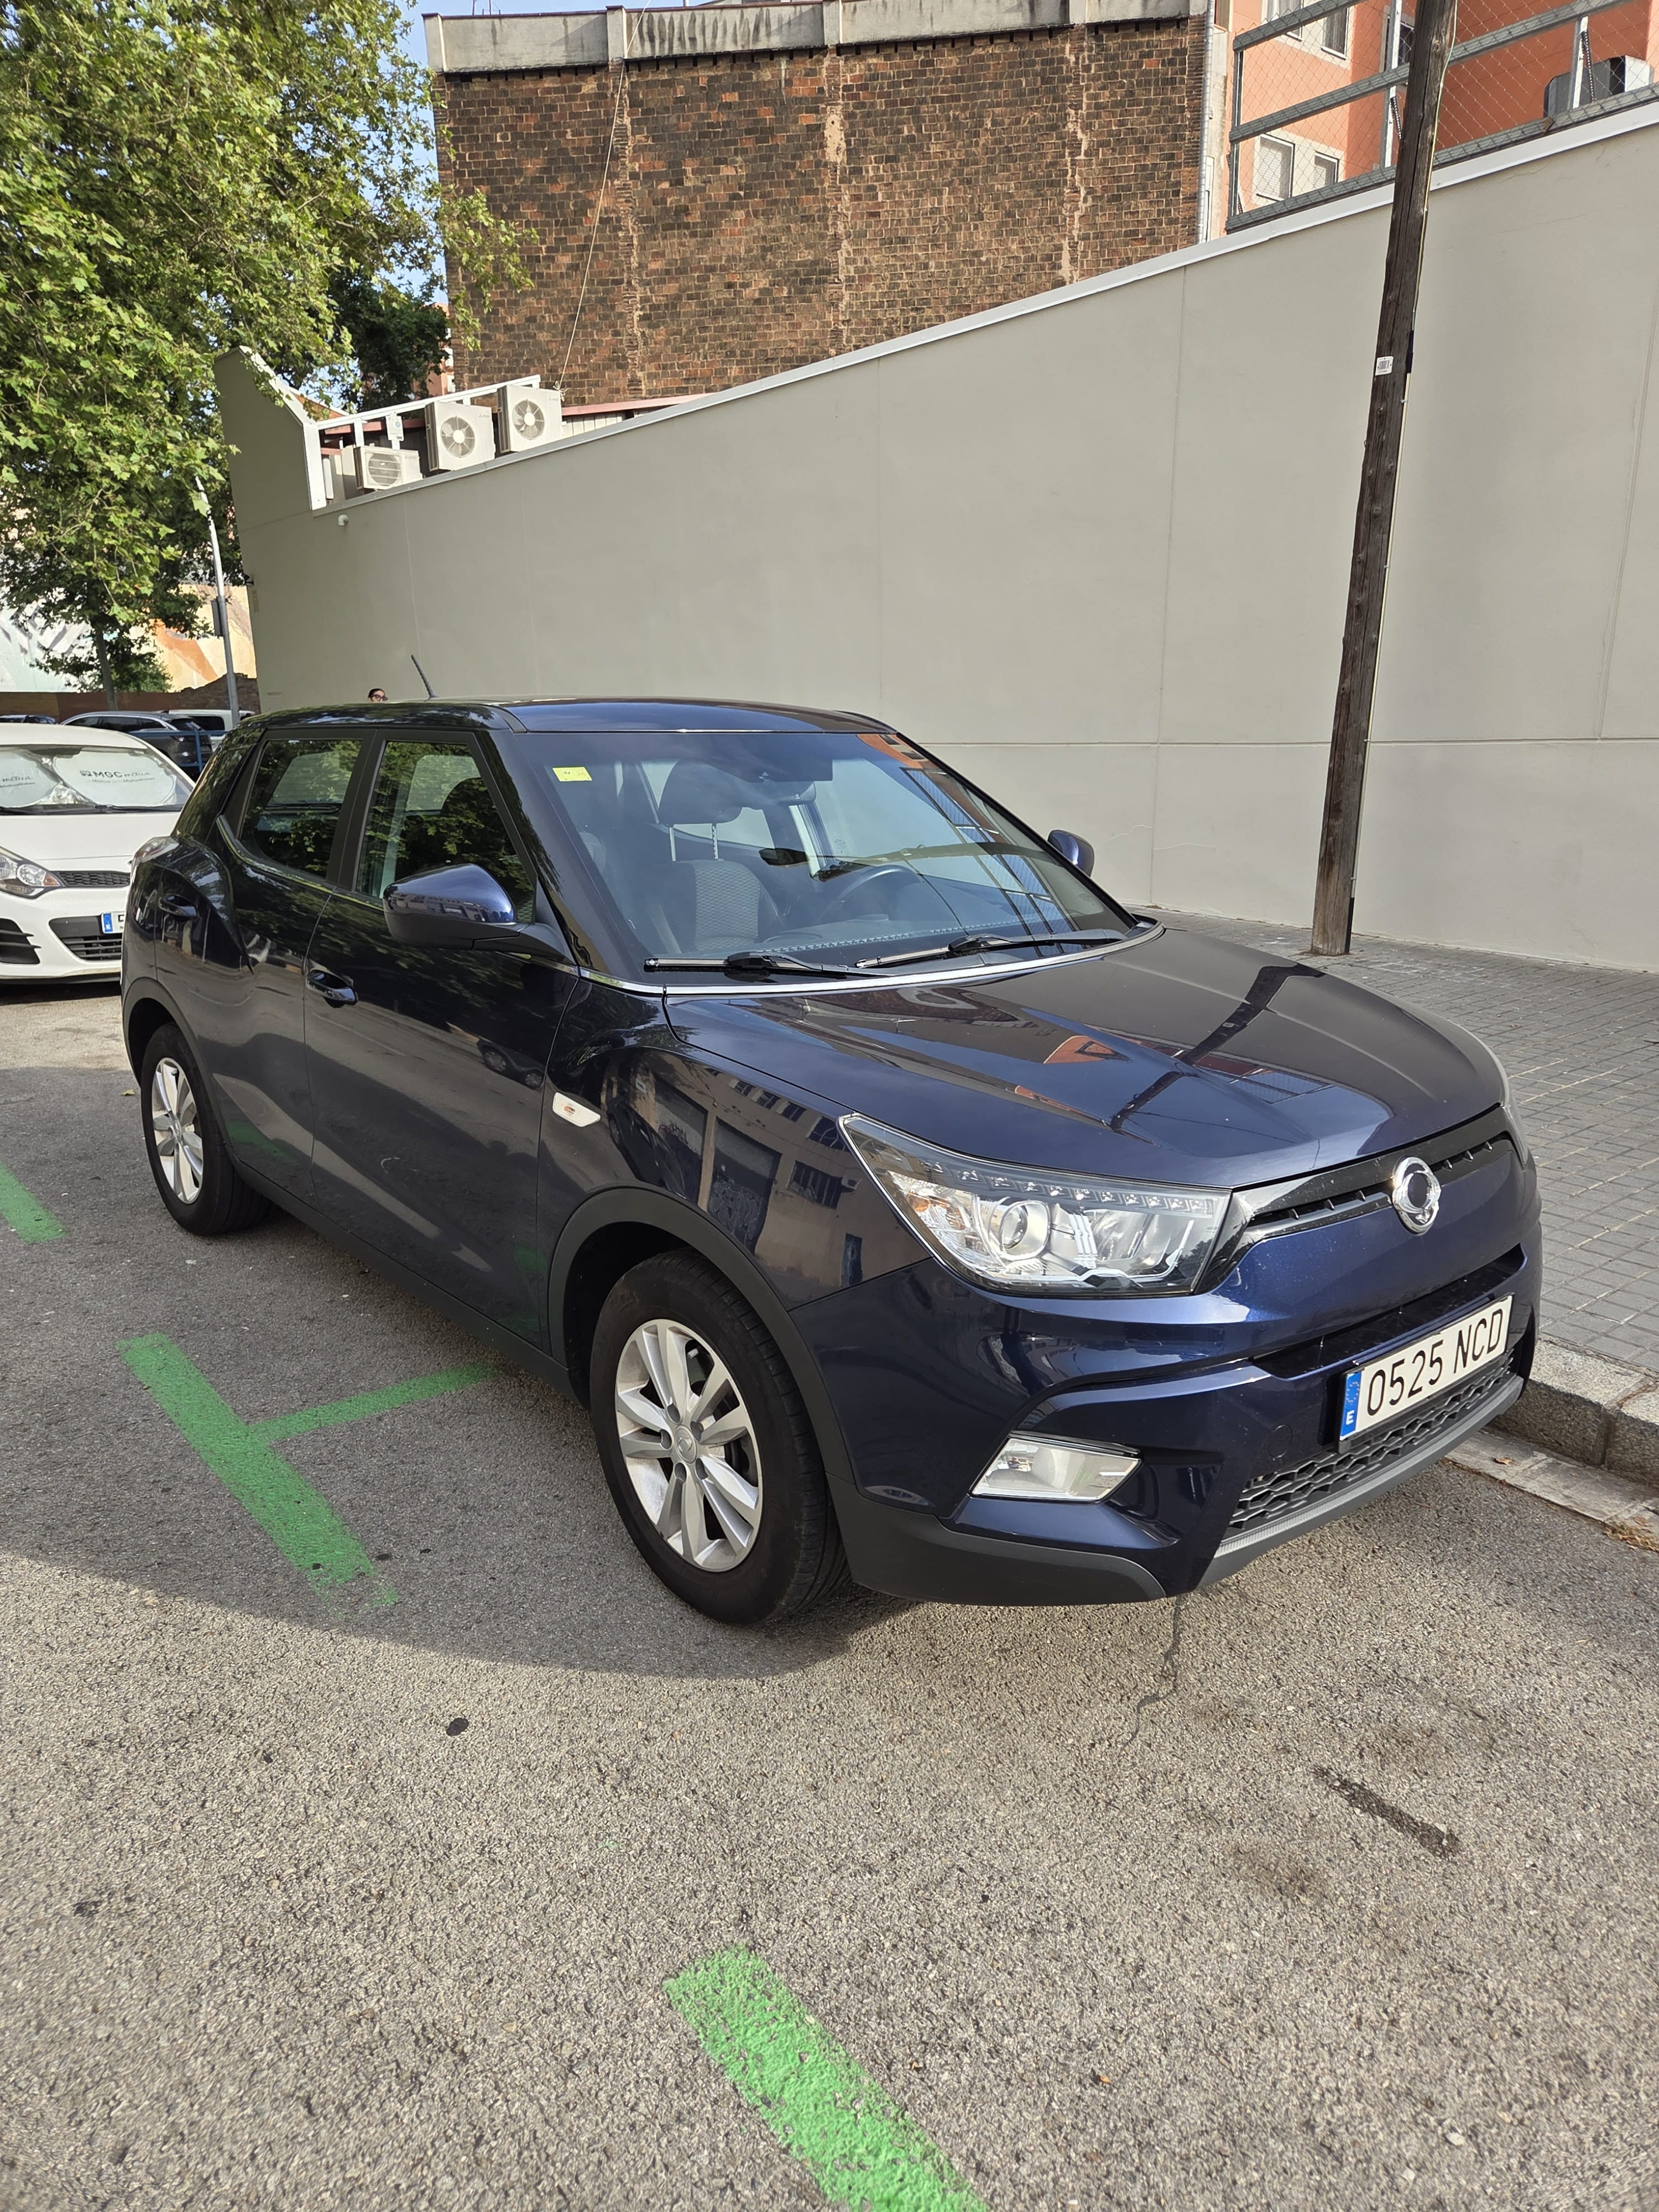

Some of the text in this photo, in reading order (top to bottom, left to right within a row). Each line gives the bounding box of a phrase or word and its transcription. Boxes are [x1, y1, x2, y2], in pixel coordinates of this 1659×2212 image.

[1367, 1308, 1504, 1416] 0525 NCD
[1345, 1410, 1354, 1426] E
